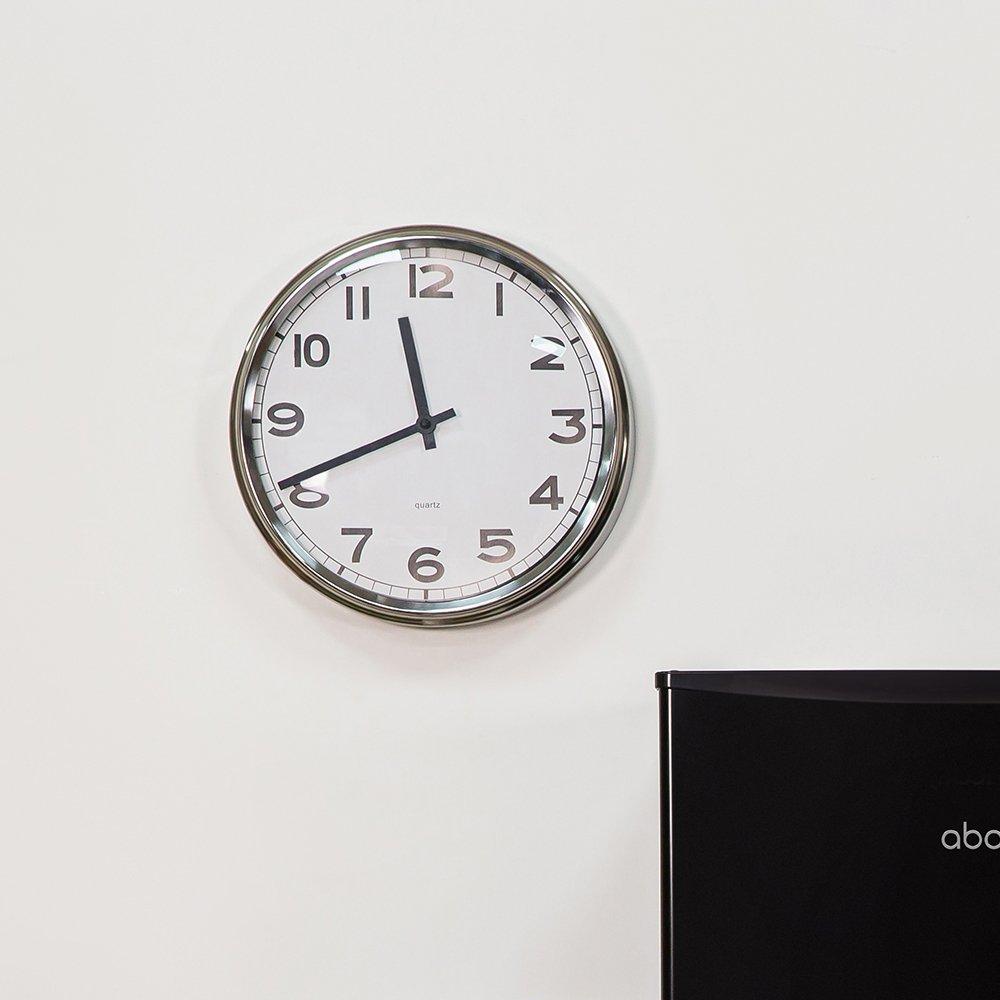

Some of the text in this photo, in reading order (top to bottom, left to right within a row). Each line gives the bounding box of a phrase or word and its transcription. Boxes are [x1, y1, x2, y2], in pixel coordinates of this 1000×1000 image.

[409, 263, 454, 299] 12
[346, 286, 370, 320] 11
[496, 282, 504, 316] 1
[294, 333, 331, 368] 10
[531, 336, 566, 371] 2
[267, 402, 305, 437] 9
[548, 409, 587, 444] 3
[414, 501, 441, 510] quartz
[529, 475, 564, 511] 4
[341, 527, 374, 564] 7
[477, 528, 517, 564] 5
[407, 546, 445, 584] 6
